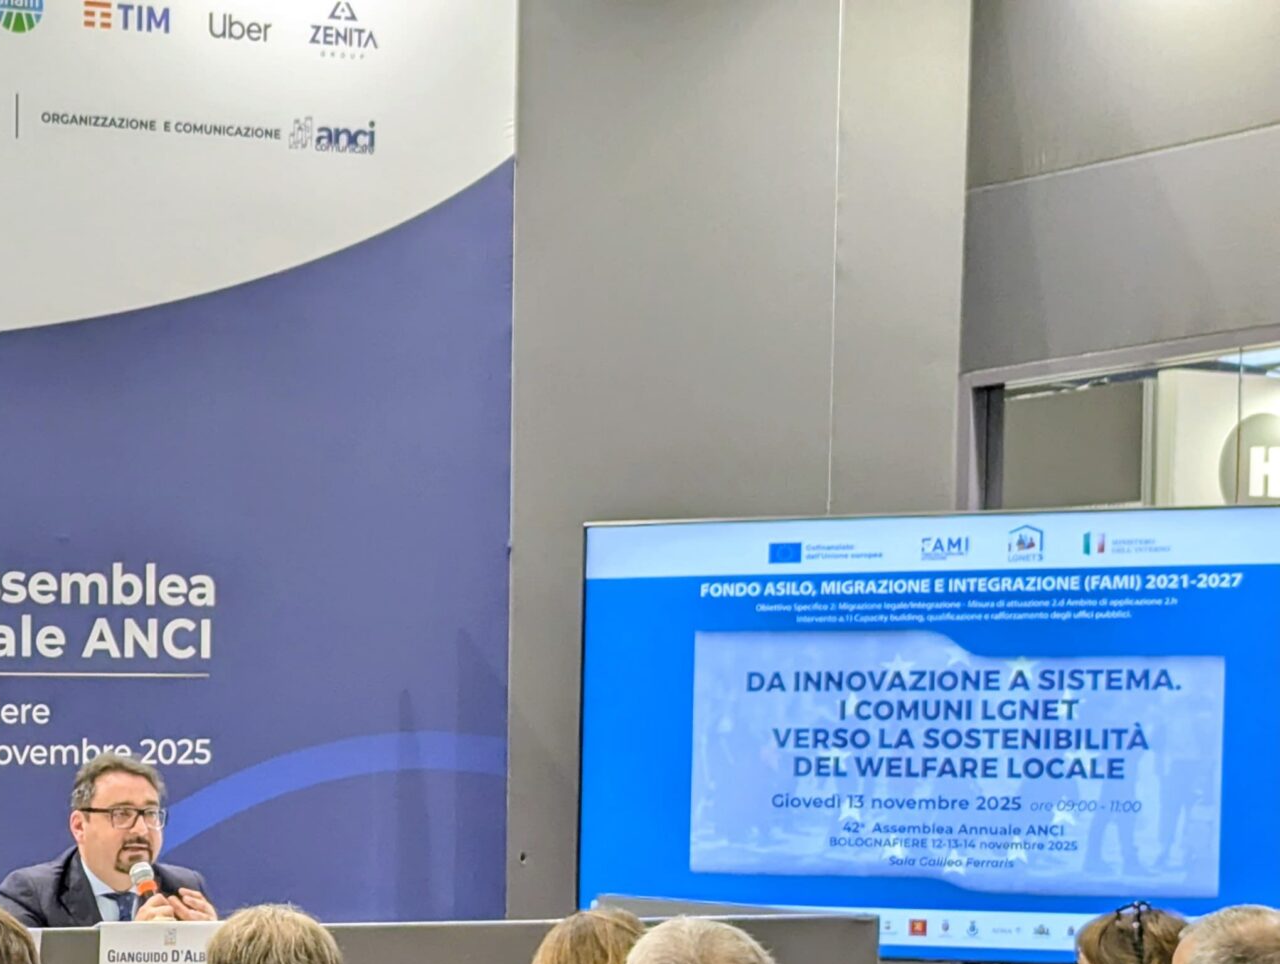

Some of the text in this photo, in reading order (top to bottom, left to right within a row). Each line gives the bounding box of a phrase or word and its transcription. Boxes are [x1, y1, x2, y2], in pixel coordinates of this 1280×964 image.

[117, 4, 170, 34] TIM
[209, 12, 272, 42] Uber
[41, 112, 281, 140] ORGANIZZAZIONE E COMUNICAZIONE
[316, 121, 375, 149] anci
[921, 536, 969, 552] FAMI
[700, 572, 1243, 598] FONDO ASILO, MIGRAZIONE E INTEGRAZIONE (FAMI) 2021-2027
[81, 618, 212, 660] ANCI
[746, 669, 1182, 692] DA INNOVAZIONE A SISTEMA.
[839, 699, 1080, 721] I COMUNI LGNET
[773, 722, 1149, 750] VERSO LA SOSTENIBILITÀ
[139, 738, 212, 765] 2025
[794, 757, 1125, 779] DEL WELFARE LOCALE
[771, 793, 841, 808] Giovedì
[847, 794, 864, 809] 13
[871, 795, 969, 810] novembre
[975, 796, 1022, 811] 2025
[1030, 801, 1053, 812] ore
[1056, 800, 1098, 812] 09:00
[1109, 800, 1142, 813] 11:00
[872, 822, 953, 834] Assemblea
[958, 824, 1021, 836] Annuale
[1025, 825, 1064, 836] ANCI
[829, 836, 1078, 851] BOLOGNAFIERE 12-13-14 novembre 2025
[888, 855, 1015, 868] Sala Galileo Ferraris
[171, 949, 206, 963] D'ALB
